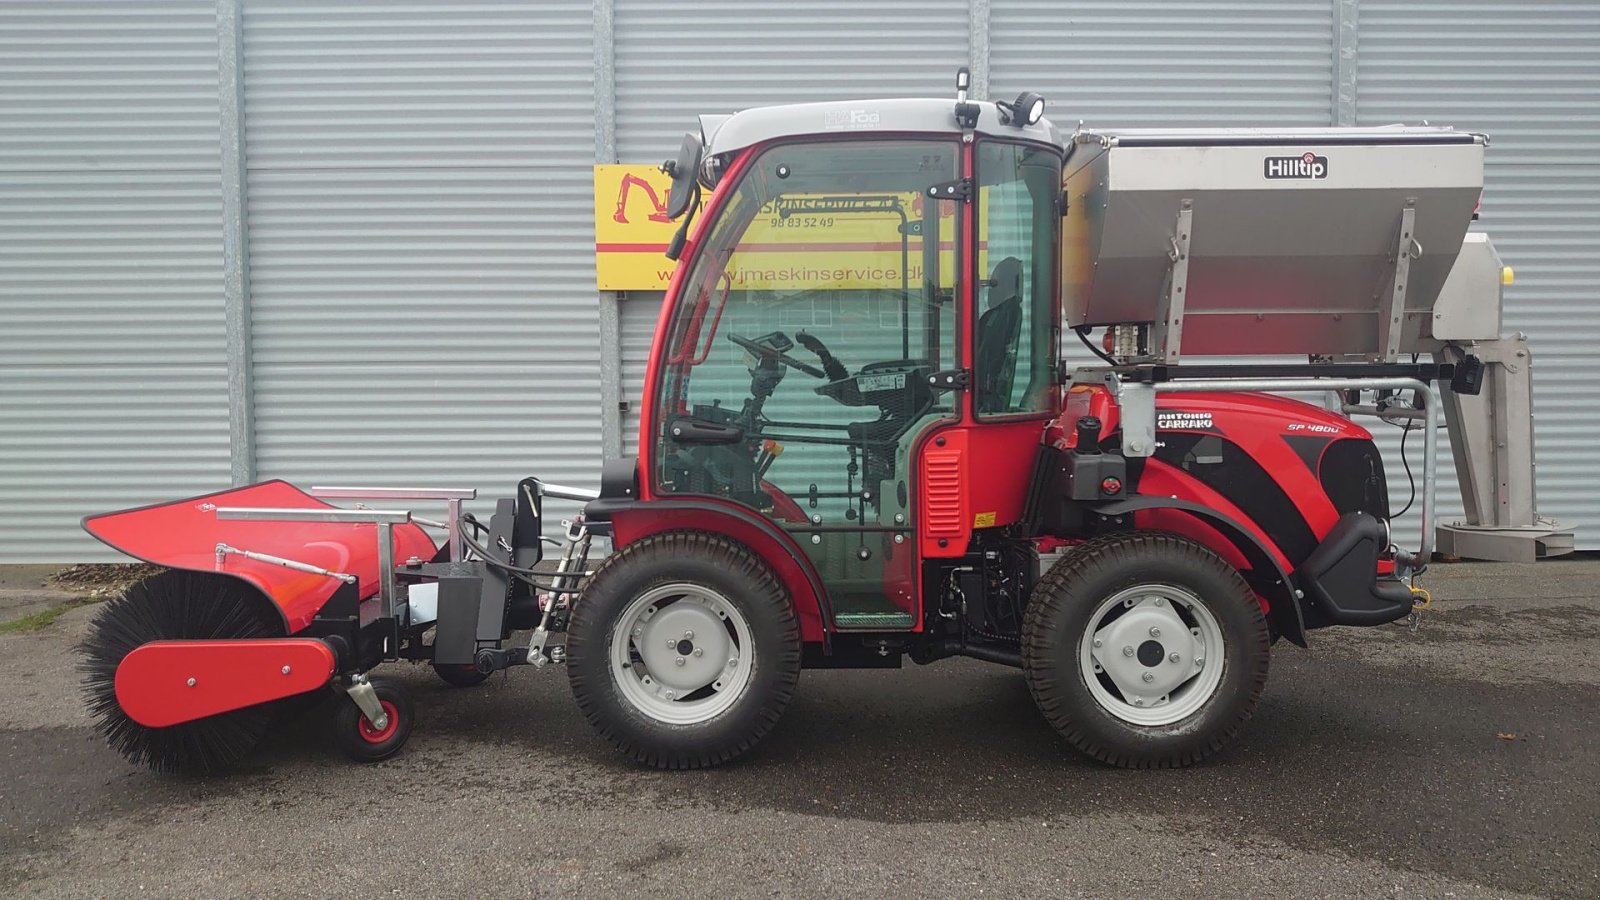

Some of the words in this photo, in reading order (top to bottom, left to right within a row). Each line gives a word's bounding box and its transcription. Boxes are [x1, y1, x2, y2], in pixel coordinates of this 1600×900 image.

[1268, 158, 1325, 180] Hilltip
[770, 218, 784, 228] 98
[787, 218, 801, 228] 83
[804, 218, 817, 228] 52
[820, 217, 834, 228] 49
[1157, 412, 1213, 420] ANTONIO
[1157, 419, 1214, 429] CARRARO
